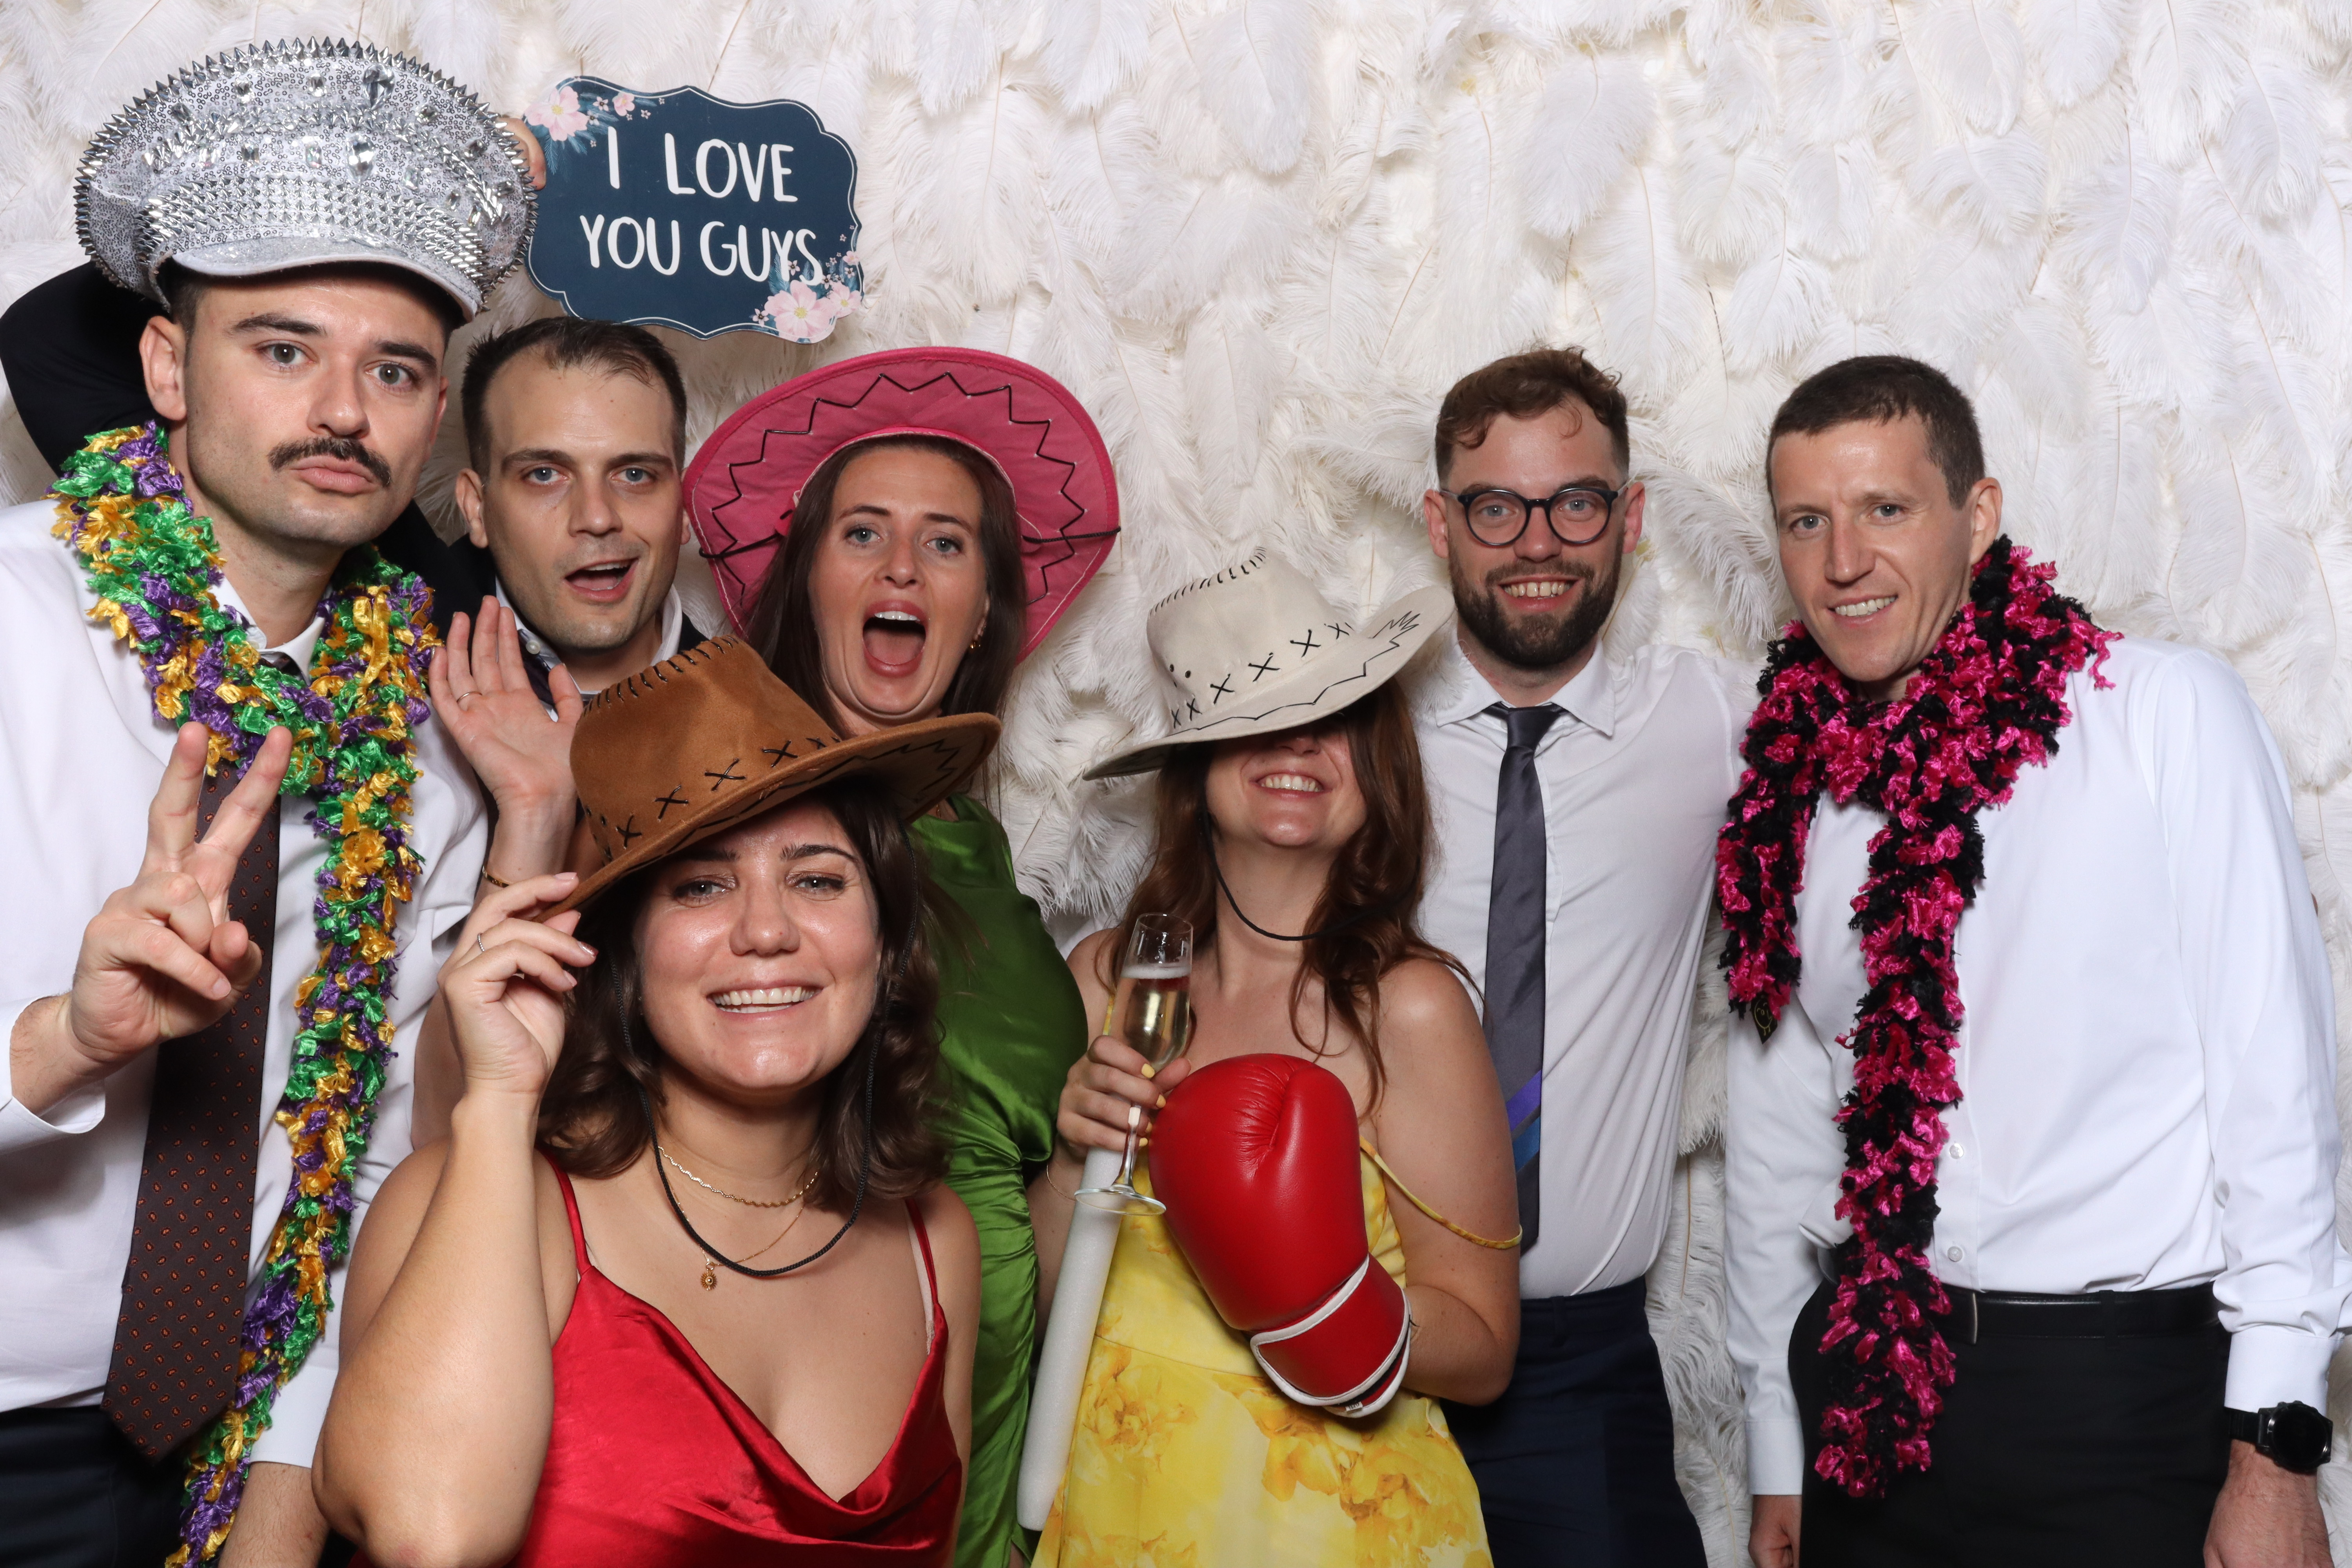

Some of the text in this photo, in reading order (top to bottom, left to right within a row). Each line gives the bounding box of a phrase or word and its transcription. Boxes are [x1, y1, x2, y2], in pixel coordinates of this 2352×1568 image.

[608, 126, 798, 202] I LOVE
[580, 214, 823, 286] YOU GUYS
